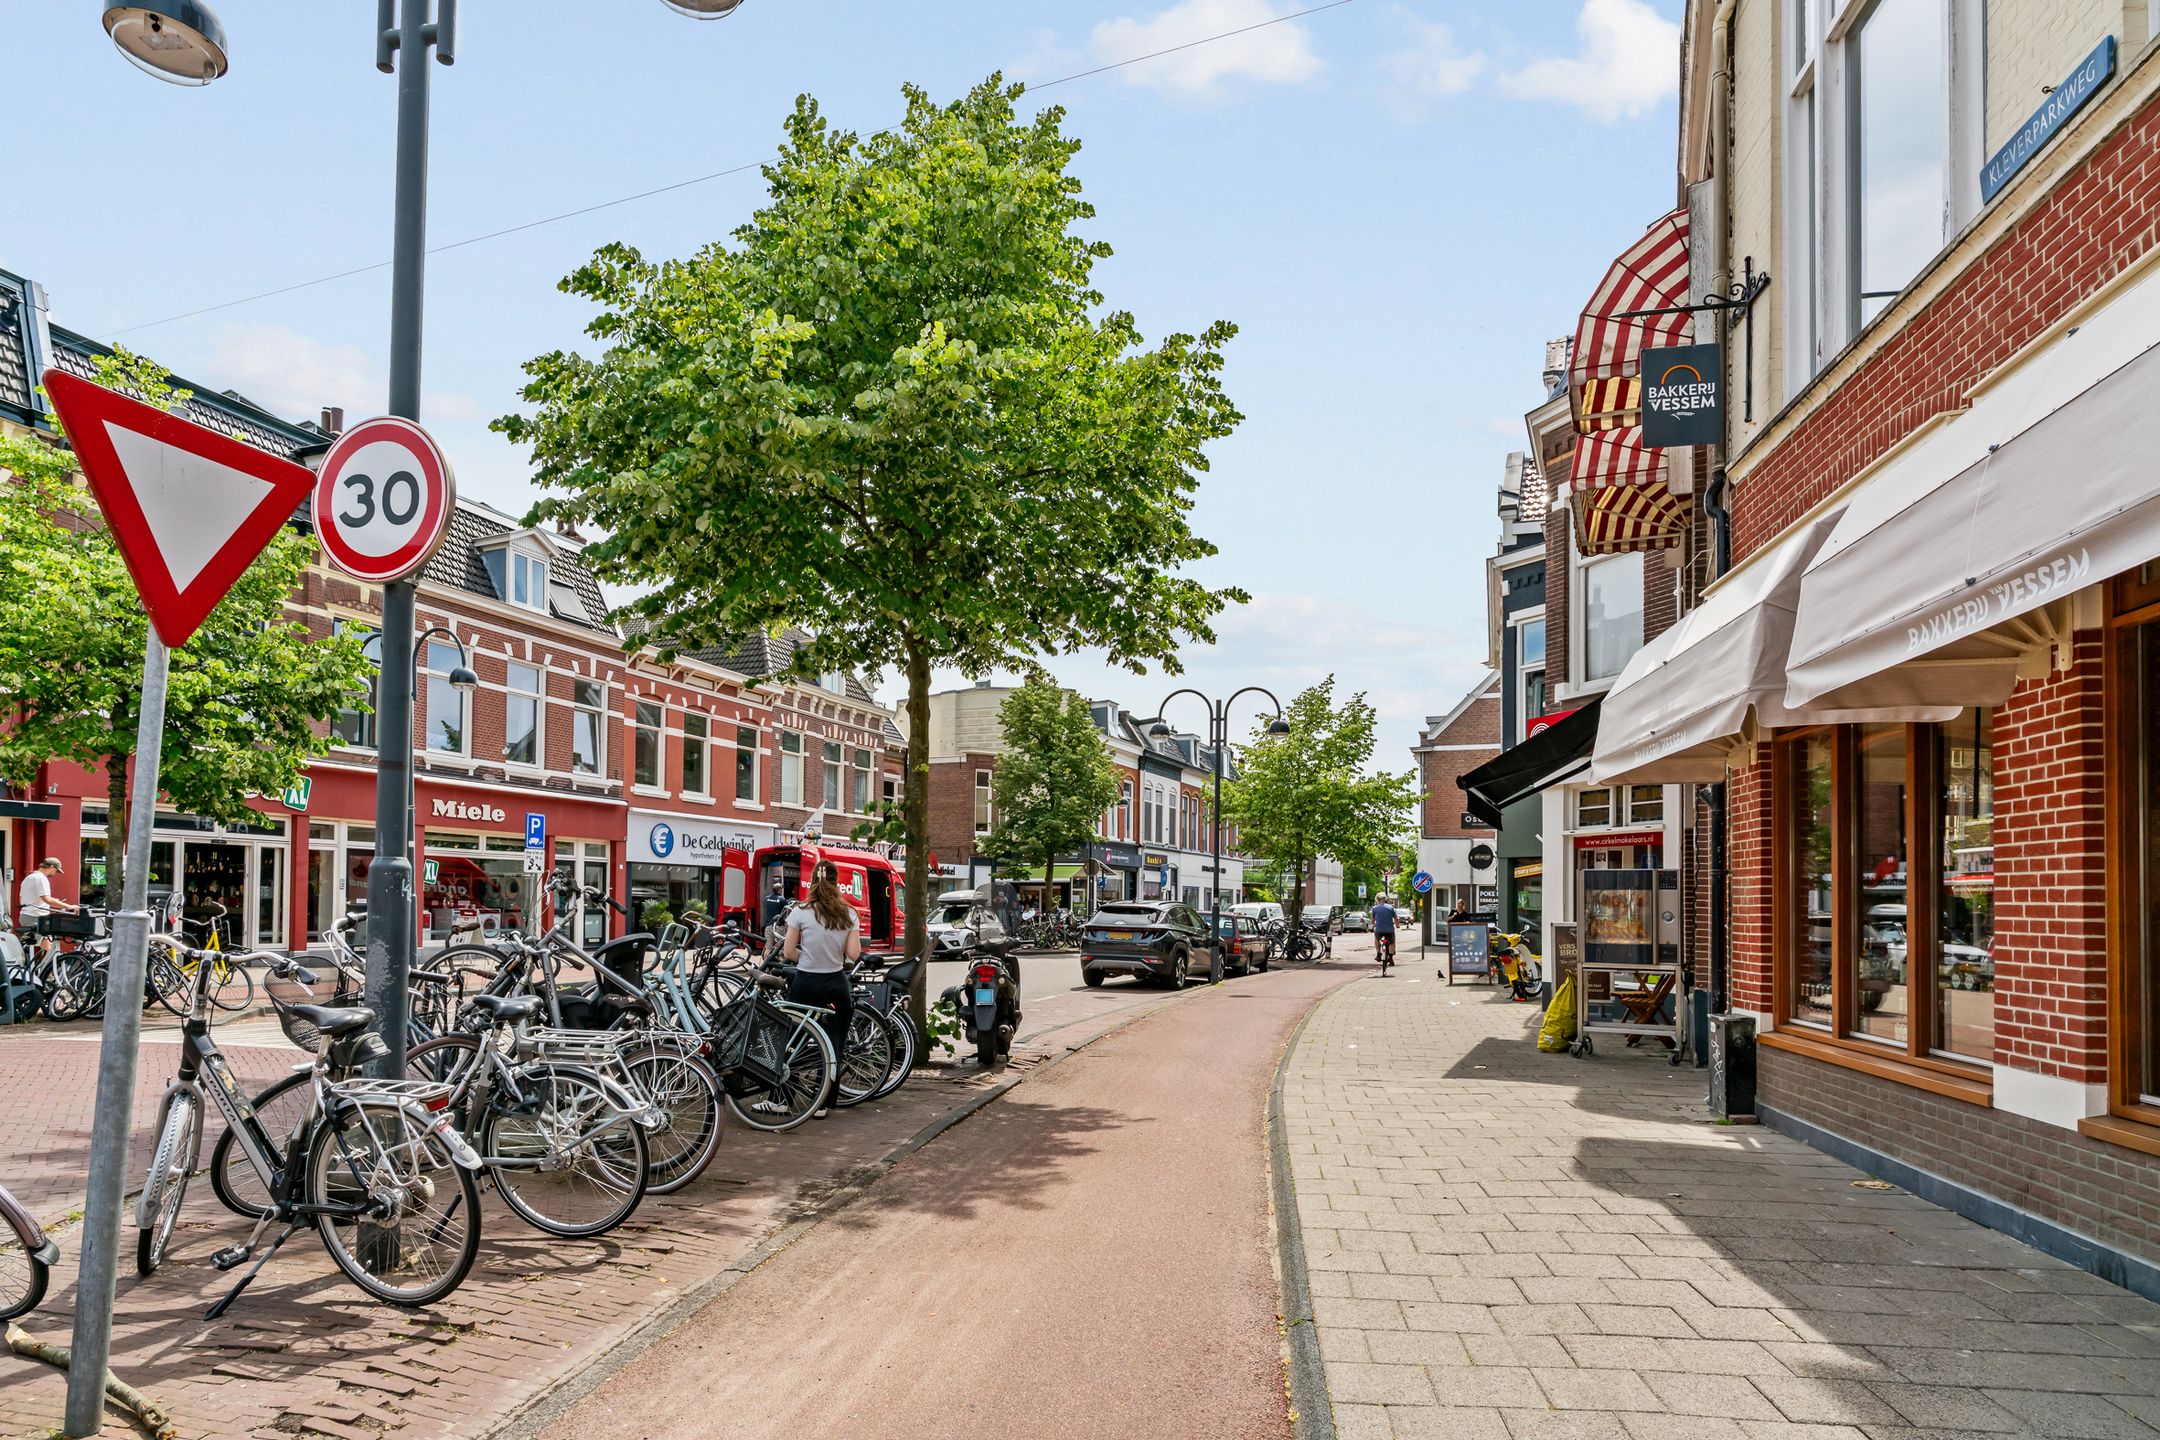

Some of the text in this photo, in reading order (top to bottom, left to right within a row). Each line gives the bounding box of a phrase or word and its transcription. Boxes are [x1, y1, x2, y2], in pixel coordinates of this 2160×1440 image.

[1988, 59, 2095, 187] KLEVERPARKWEG
[1648, 382, 1715, 399] BAKKERIJ
[1650, 395, 1715, 412] VESSEM
[339, 470, 420, 529] 30
[1906, 594, 1990, 652] BAKKERIJ
[1997, 547, 2091, 612] VESSEM
[432, 799, 505, 822] Miele
[531, 817, 541, 834] P
[682, 833, 755, 853] De Geldwinkel
[1585, 834, 1654, 846] www.cirkelmakelaars.nl
[690, 852, 715, 861] hypotheken
[425, 862, 437, 881] XL
[205, 1073, 236, 1122] SPARTA
